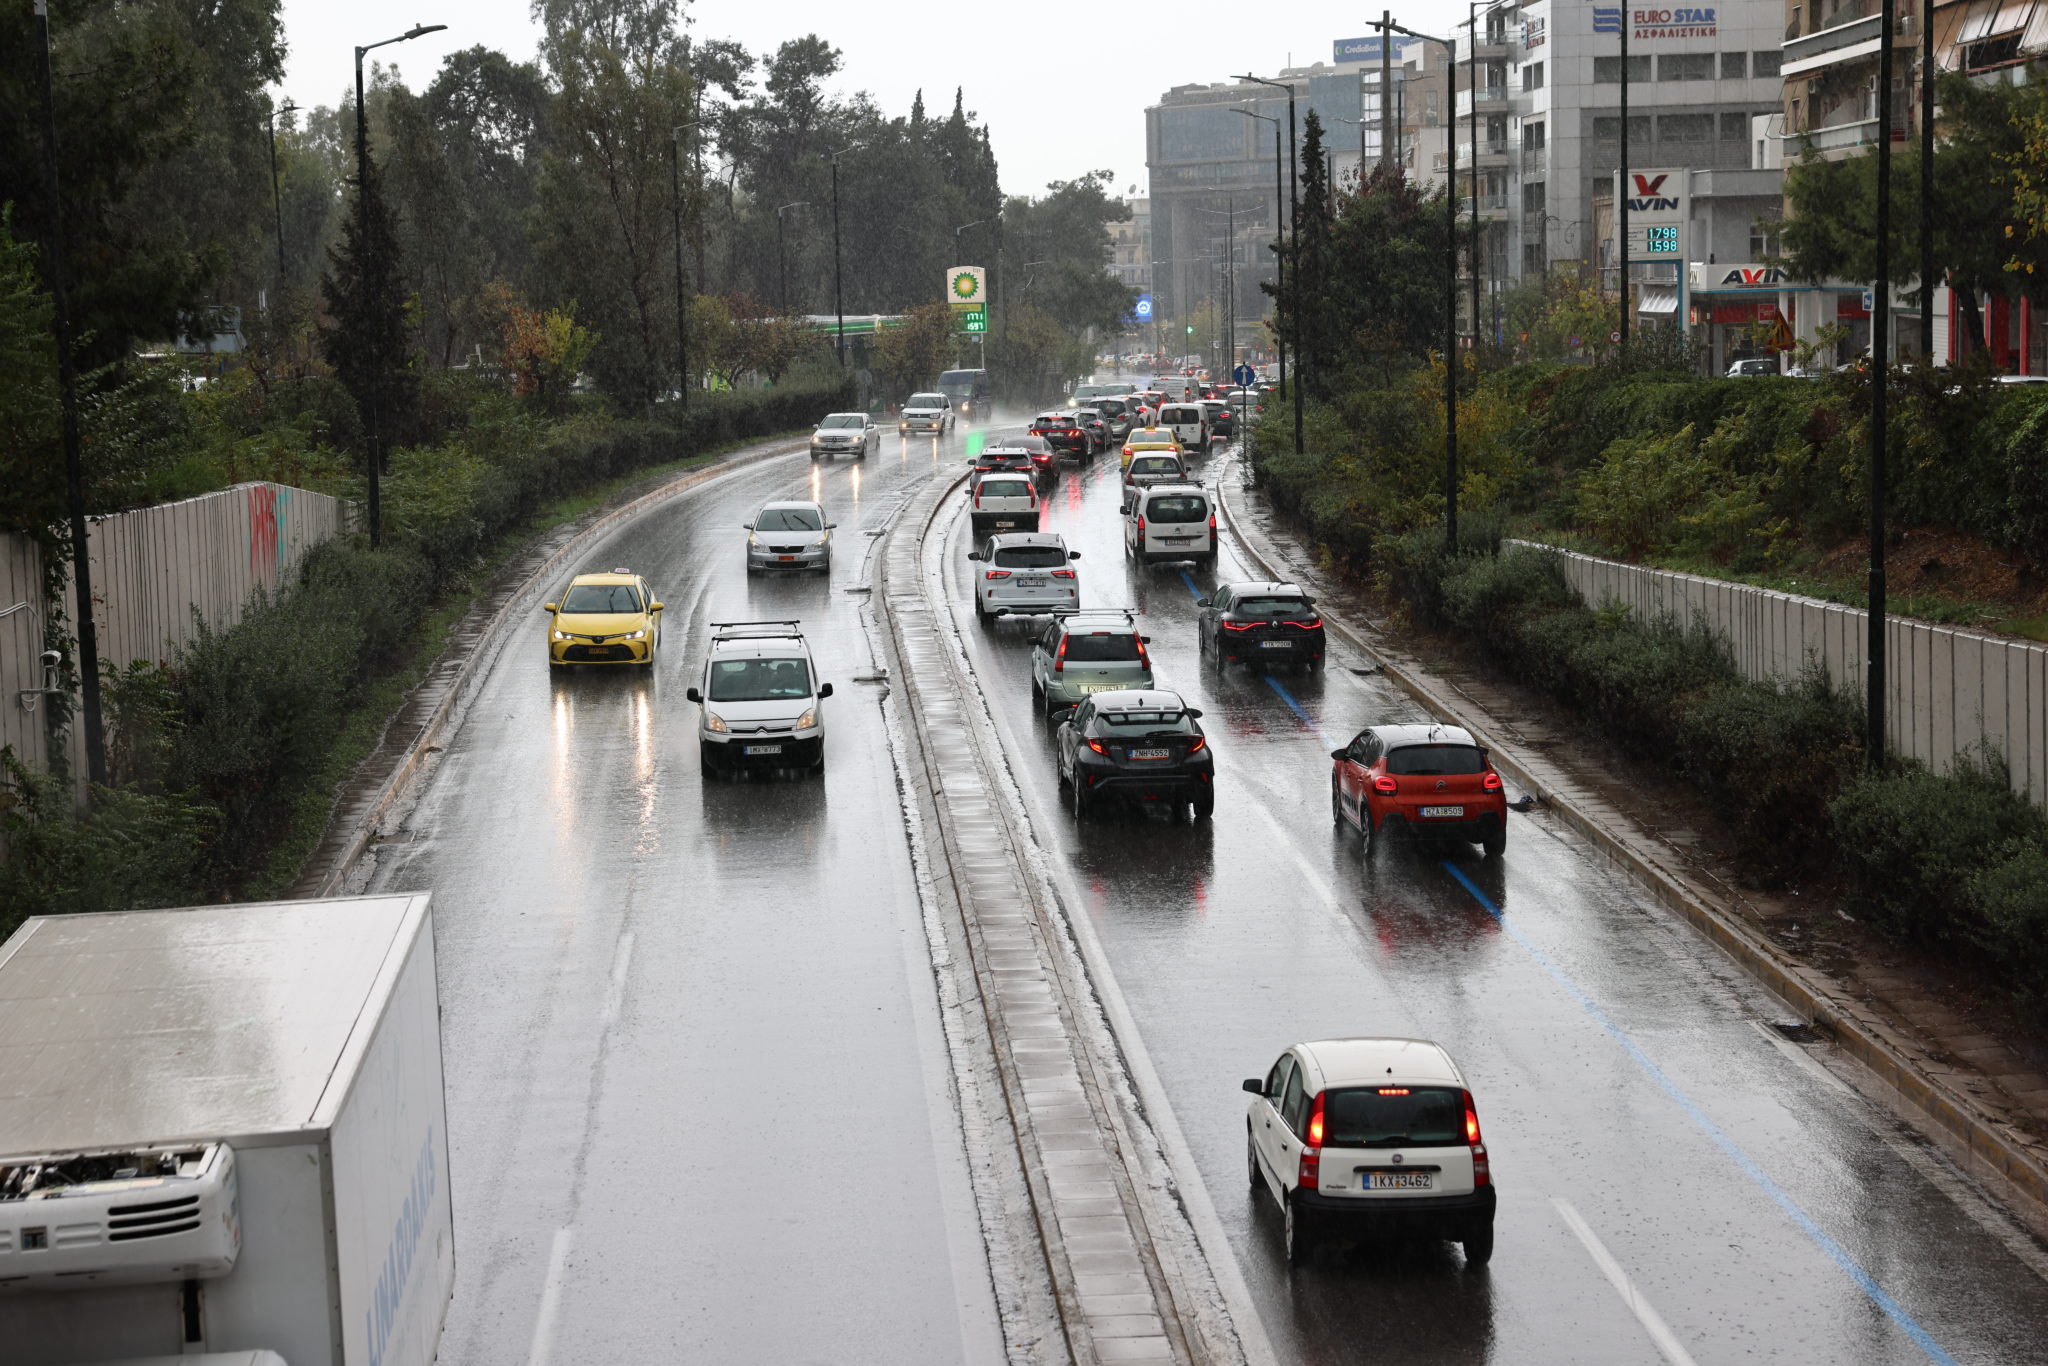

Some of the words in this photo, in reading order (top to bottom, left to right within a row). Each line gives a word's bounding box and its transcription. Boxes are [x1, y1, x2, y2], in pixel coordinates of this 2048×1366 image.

[1634, 10, 1671, 24] EURO
[1674, 8, 1716, 22] STAR
[1634, 27, 1716, 39] ΑΣΦΑΛΙΣΤΙΚΗ
